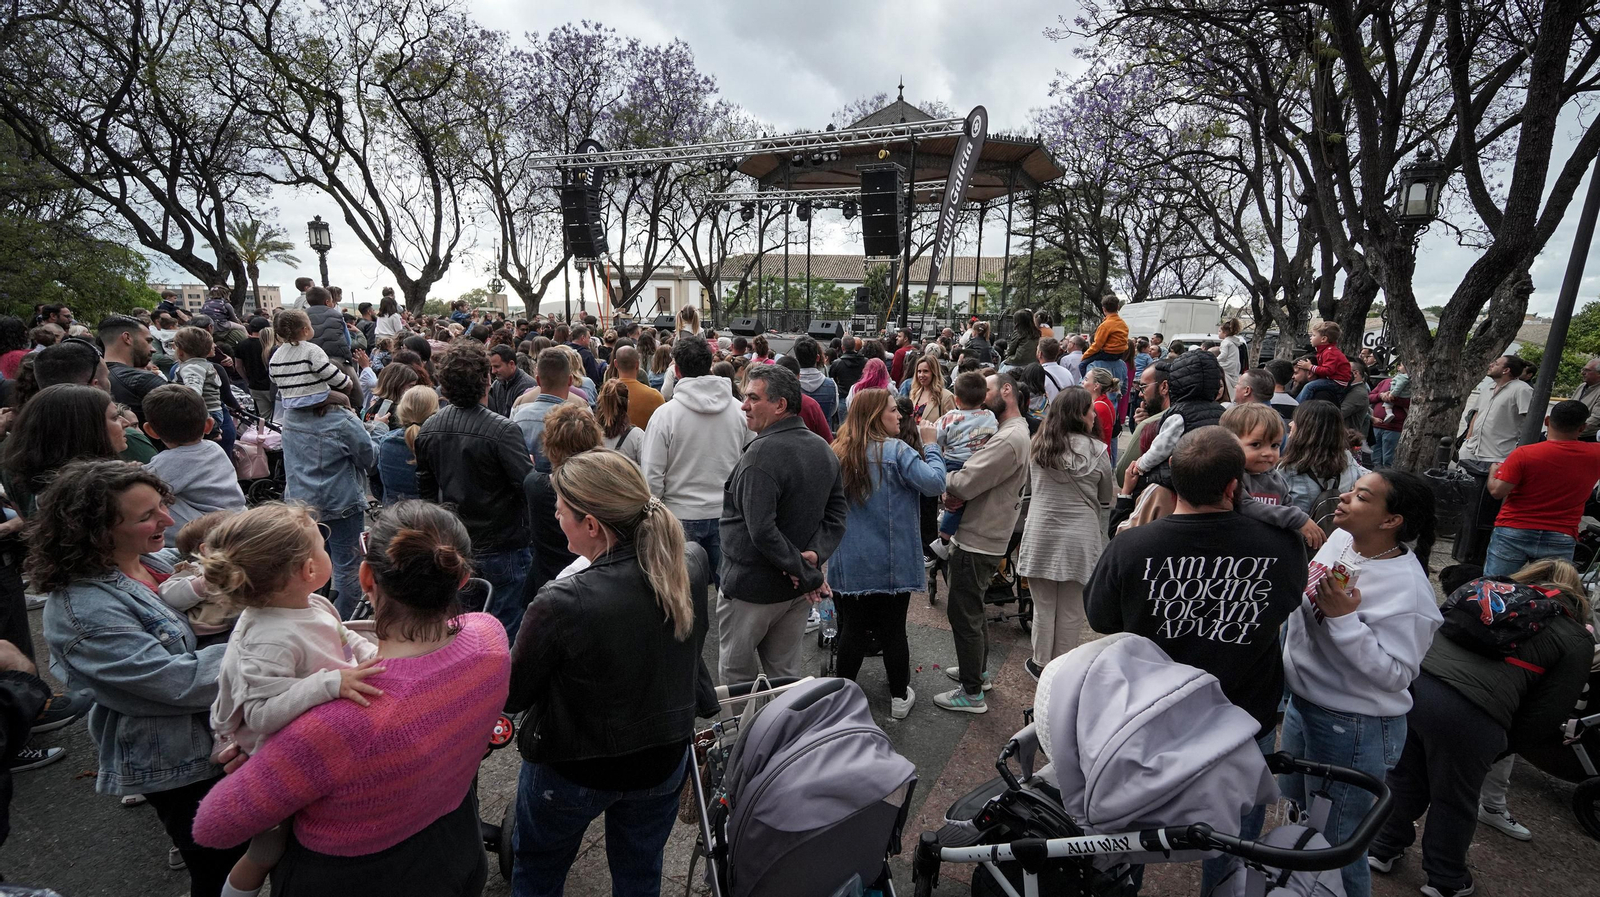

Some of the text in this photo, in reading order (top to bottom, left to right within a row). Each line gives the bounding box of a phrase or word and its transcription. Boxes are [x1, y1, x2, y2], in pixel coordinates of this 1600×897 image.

[934, 142, 973, 270] Estrella Galicia
[1142, 556, 1278, 581] I AM NOT
[1147, 578, 1273, 602] LOOKING
[1151, 599, 1270, 624] FOR ANY
[1156, 617, 1261, 645] ADVICE
[1067, 836, 1132, 855] ALU WAY
